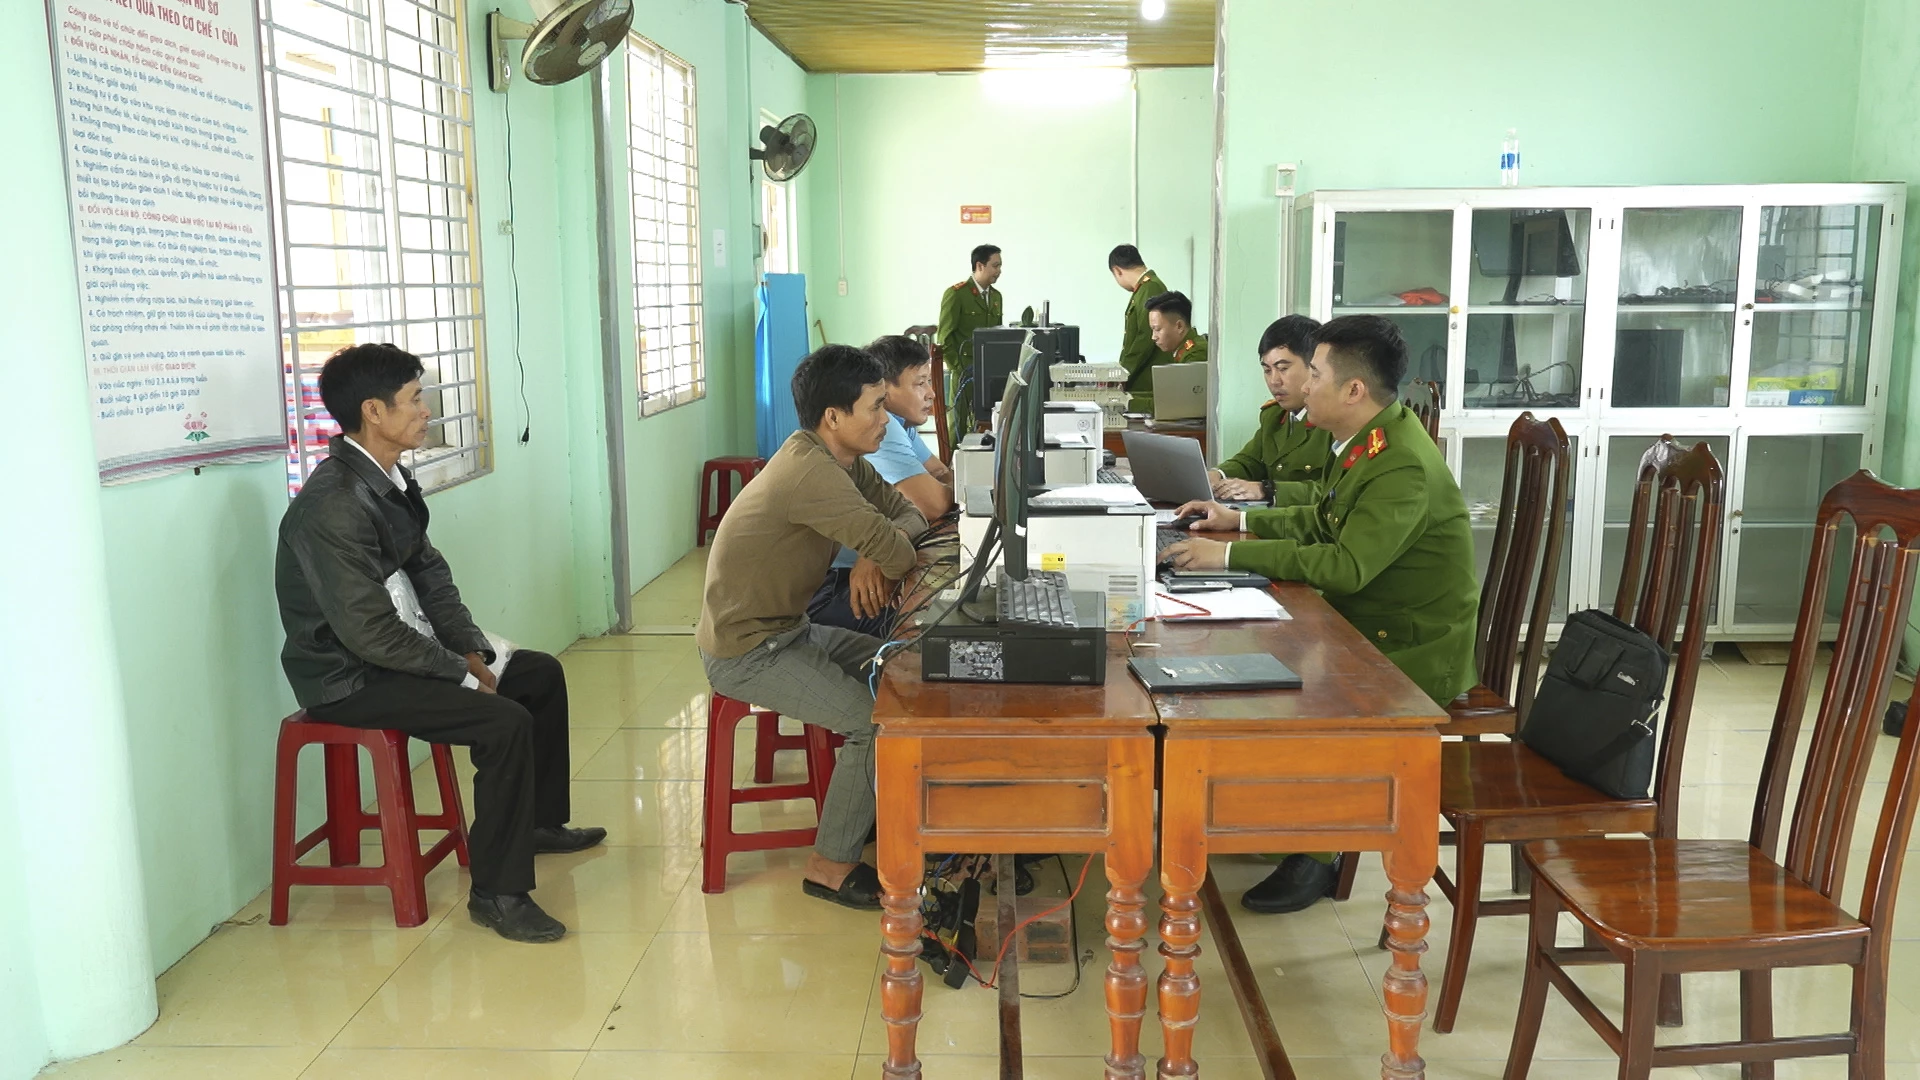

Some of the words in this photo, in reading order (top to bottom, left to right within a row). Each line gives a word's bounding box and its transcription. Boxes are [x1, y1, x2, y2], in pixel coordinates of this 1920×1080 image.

[158, 4, 180, 26] THEO
[196, 20, 212, 38] CHẾ
[214, 27, 219, 40] 1
[222, 26, 238, 47] CỬA
